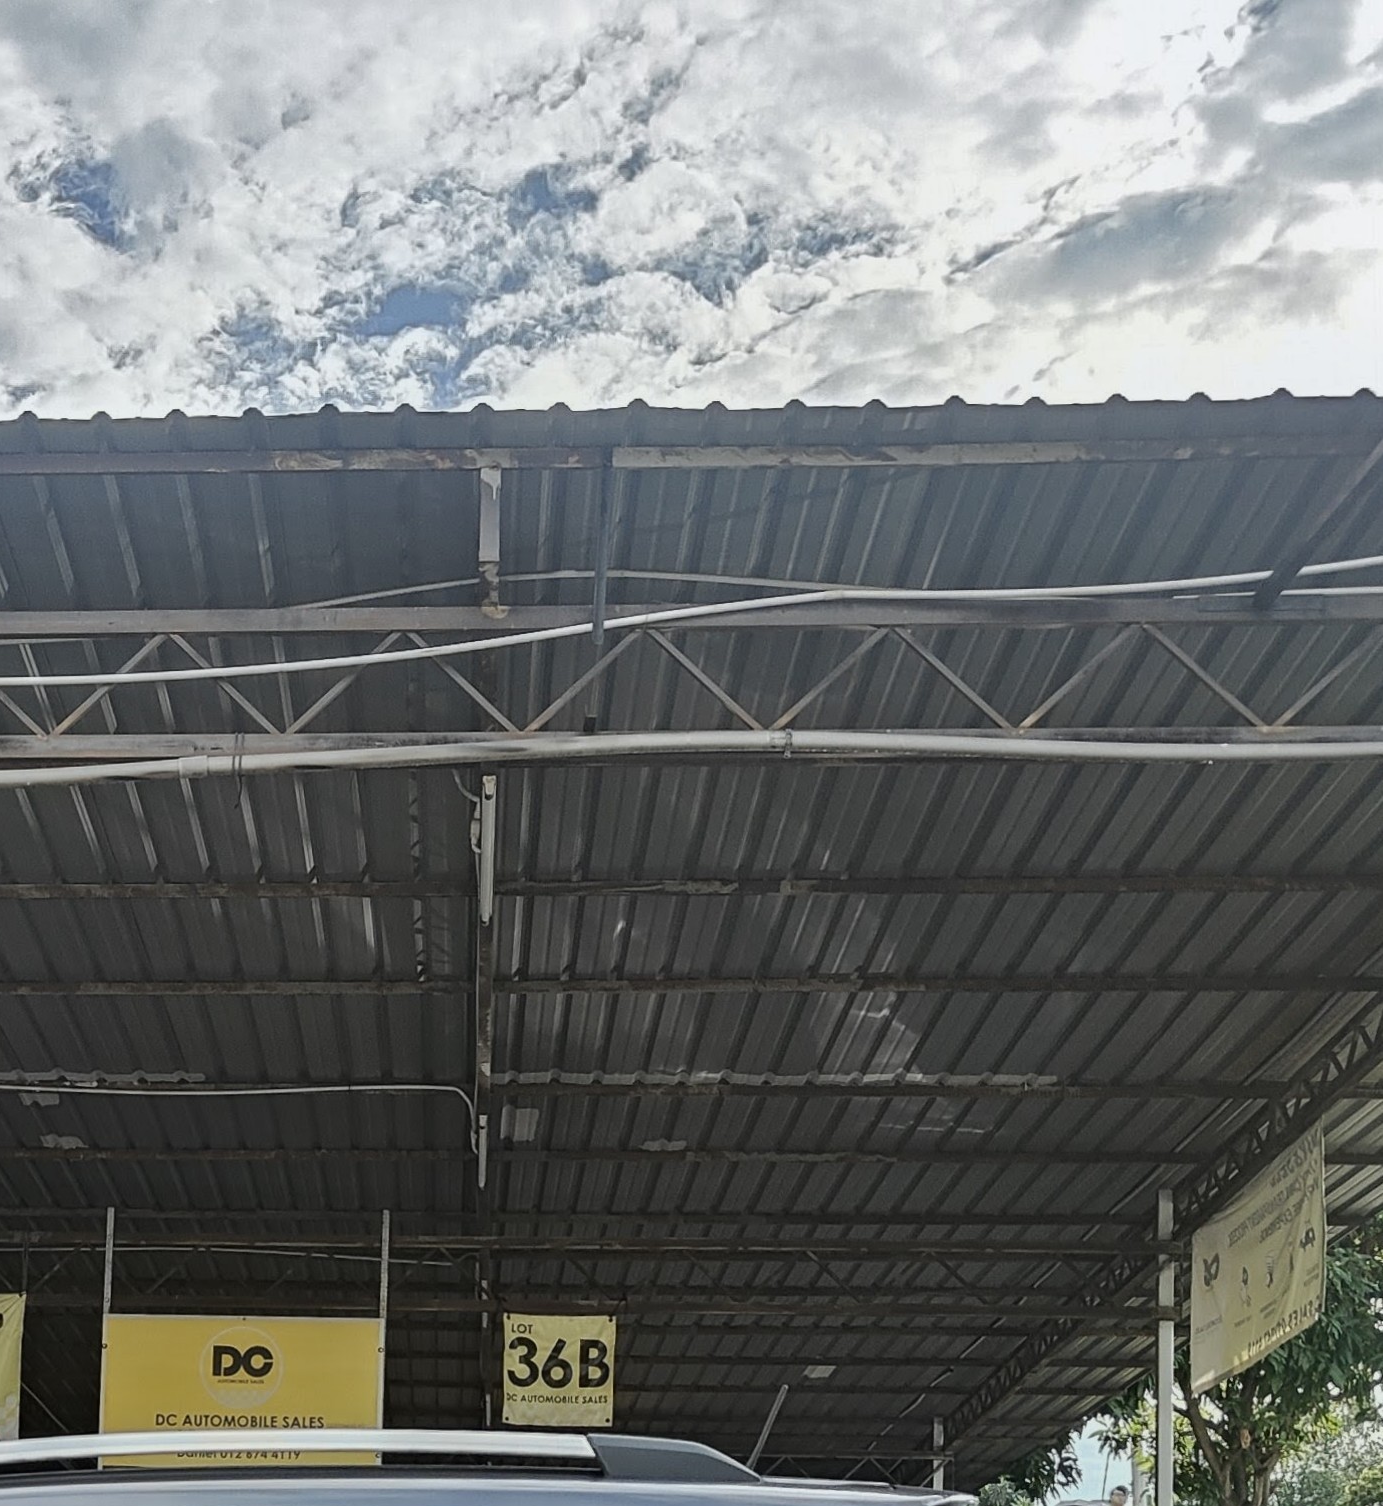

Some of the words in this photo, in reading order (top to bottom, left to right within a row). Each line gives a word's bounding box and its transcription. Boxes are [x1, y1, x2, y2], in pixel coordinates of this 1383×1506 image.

[511, 1323, 533, 1334] LOT
[212, 1345, 274, 1378] DC
[507, 1336, 610, 1388] 36B
[506, 1392, 518, 1401] DC
[520, 1394, 579, 1404] AUTOMOBILE
[581, 1395, 608, 1404] SALES
[155, 1413, 177, 1426] DC
[182, 1414, 278, 1428] AUTOMOBILE
[282, 1416, 325, 1429] SALES
